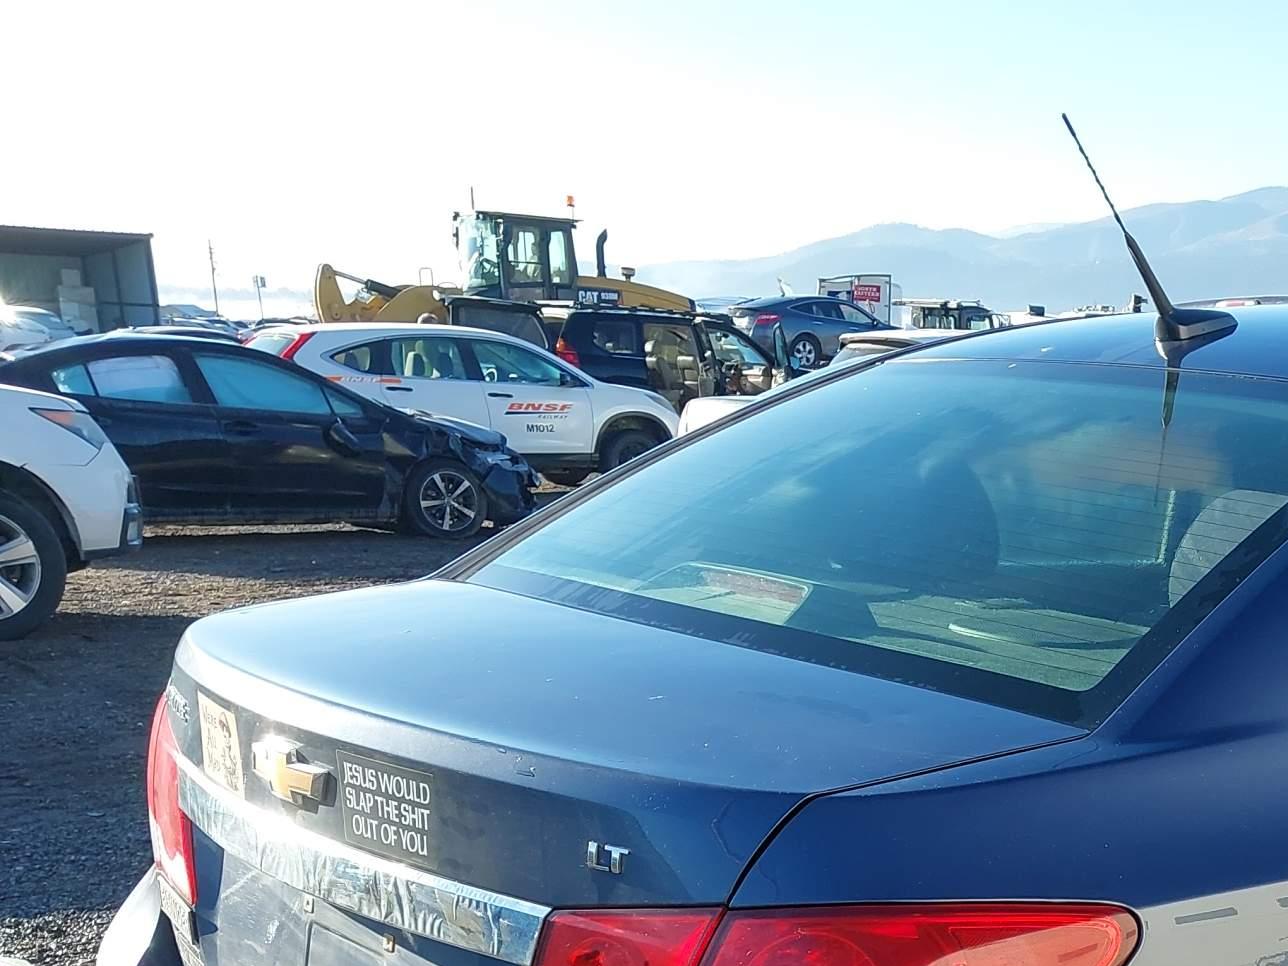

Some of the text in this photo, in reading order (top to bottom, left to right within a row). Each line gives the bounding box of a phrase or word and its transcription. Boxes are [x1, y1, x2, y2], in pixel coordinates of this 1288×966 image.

[578, 290, 599, 305] CAT
[507, 402, 574, 411] BNSF
[526, 423, 555, 433] M1012
[343, 761, 430, 805] JESUS WOULD
[345, 786, 430, 831] SLAP THE SHIT
[352, 814, 428, 856] OUT OF YOU
[587, 840, 630, 874] LT
